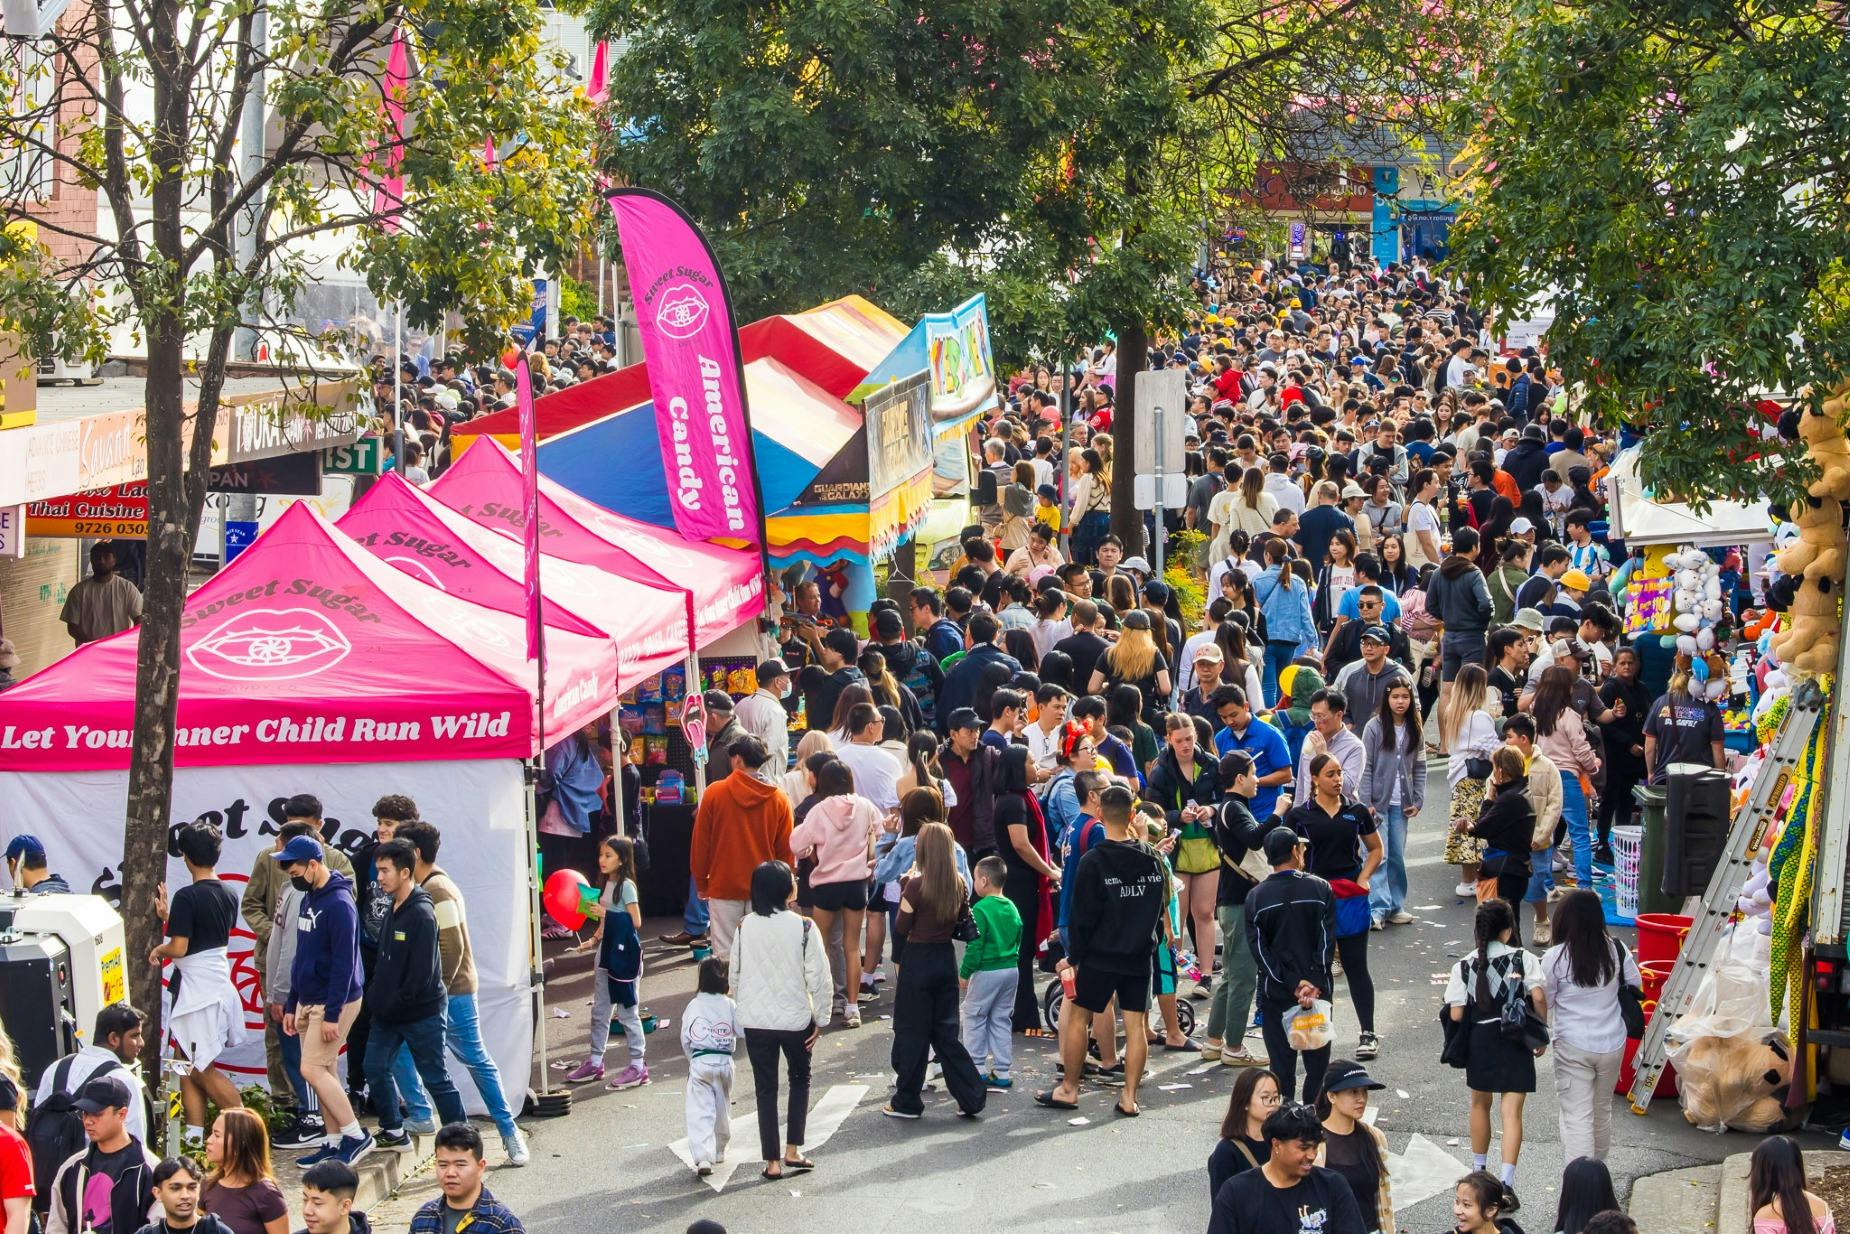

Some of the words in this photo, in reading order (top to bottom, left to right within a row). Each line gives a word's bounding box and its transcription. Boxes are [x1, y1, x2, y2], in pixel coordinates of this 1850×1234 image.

[644, 268, 675, 305] Sweet
[676, 265, 713, 289] Sugar
[669, 396, 703, 511] Candy
[697, 354, 745, 532] American
[29, 502, 70, 517] Thai
[74, 502, 145, 518] Cuisine
[75, 522, 112, 534] 9726
[384, 531, 471, 569] Sugar
[284, 578, 381, 624] Sugar
[1, 725, 55, 749] Let
[64, 725, 133, 749] You
[174, 724, 249, 746] nner
[255, 717, 346, 742] Child
[350, 718, 420, 741] Run
[430, 712, 510, 739] Wild
[1120, 885, 1147, 898] ADLV
[1147, 874, 1162, 884] vie
